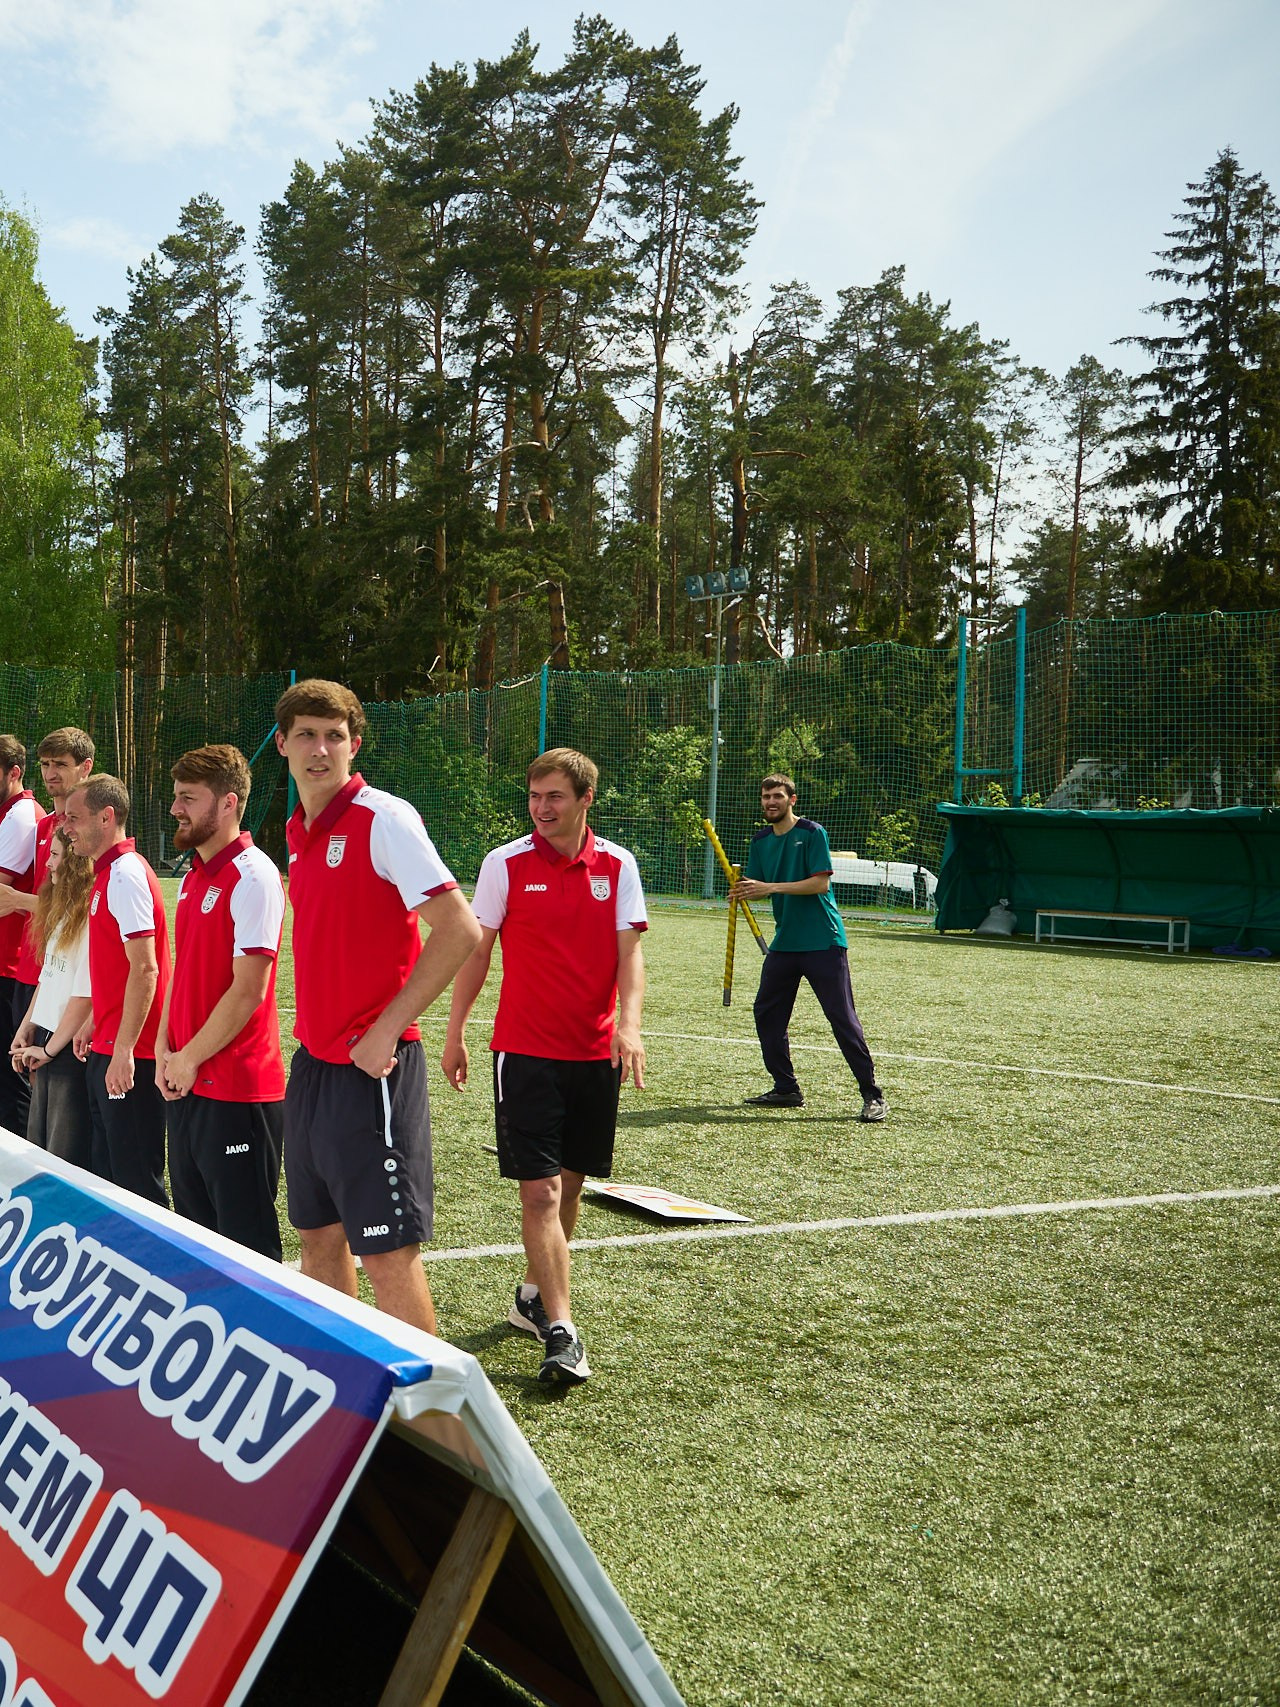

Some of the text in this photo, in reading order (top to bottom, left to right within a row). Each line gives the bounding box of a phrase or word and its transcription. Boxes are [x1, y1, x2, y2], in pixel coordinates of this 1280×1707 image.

[524, 884, 548, 892] JAKO
[225, 1143, 250, 1155] JAKO
[362, 1224, 390, 1238] JAKO
[18, 1236, 321, 1465] ФУТБОЛУ
[76, 1505, 208, 1678] ЦП
